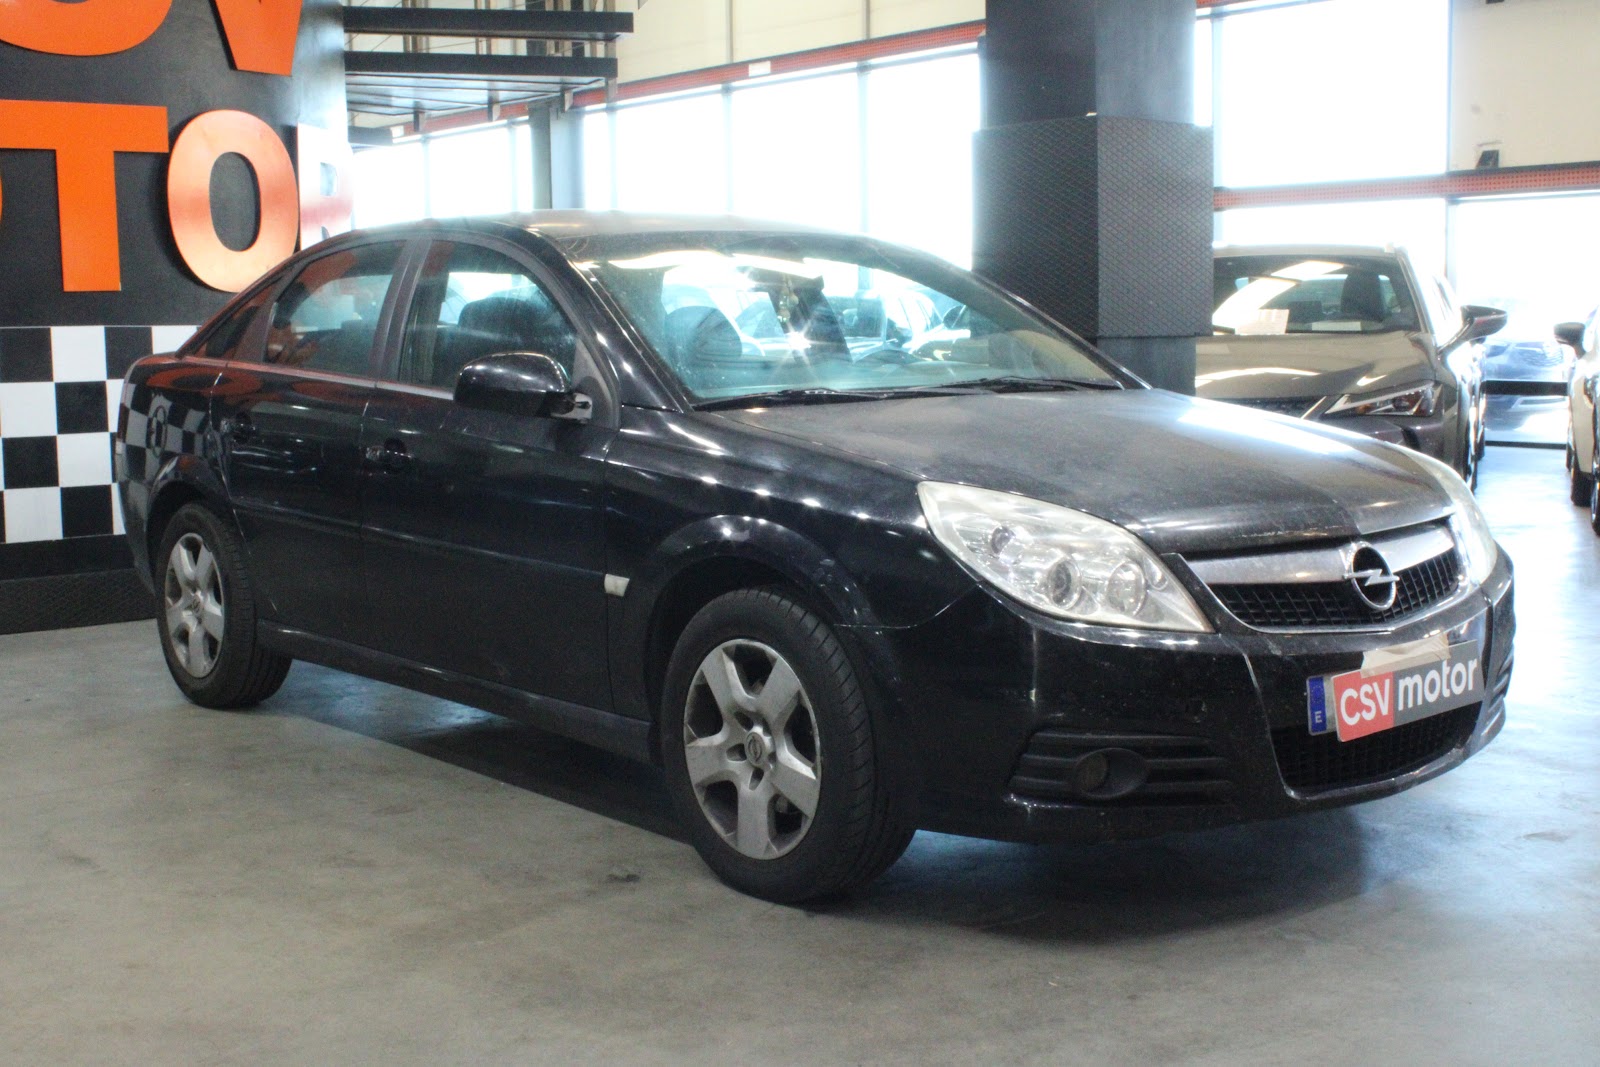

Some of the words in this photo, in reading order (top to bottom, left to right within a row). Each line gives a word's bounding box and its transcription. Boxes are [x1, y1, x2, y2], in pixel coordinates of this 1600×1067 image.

[0, 99, 353, 293] TOR
[1314, 710, 1323, 724] E
[1340, 679, 1390, 726] CSV
[1397, 657, 1478, 711] motor
